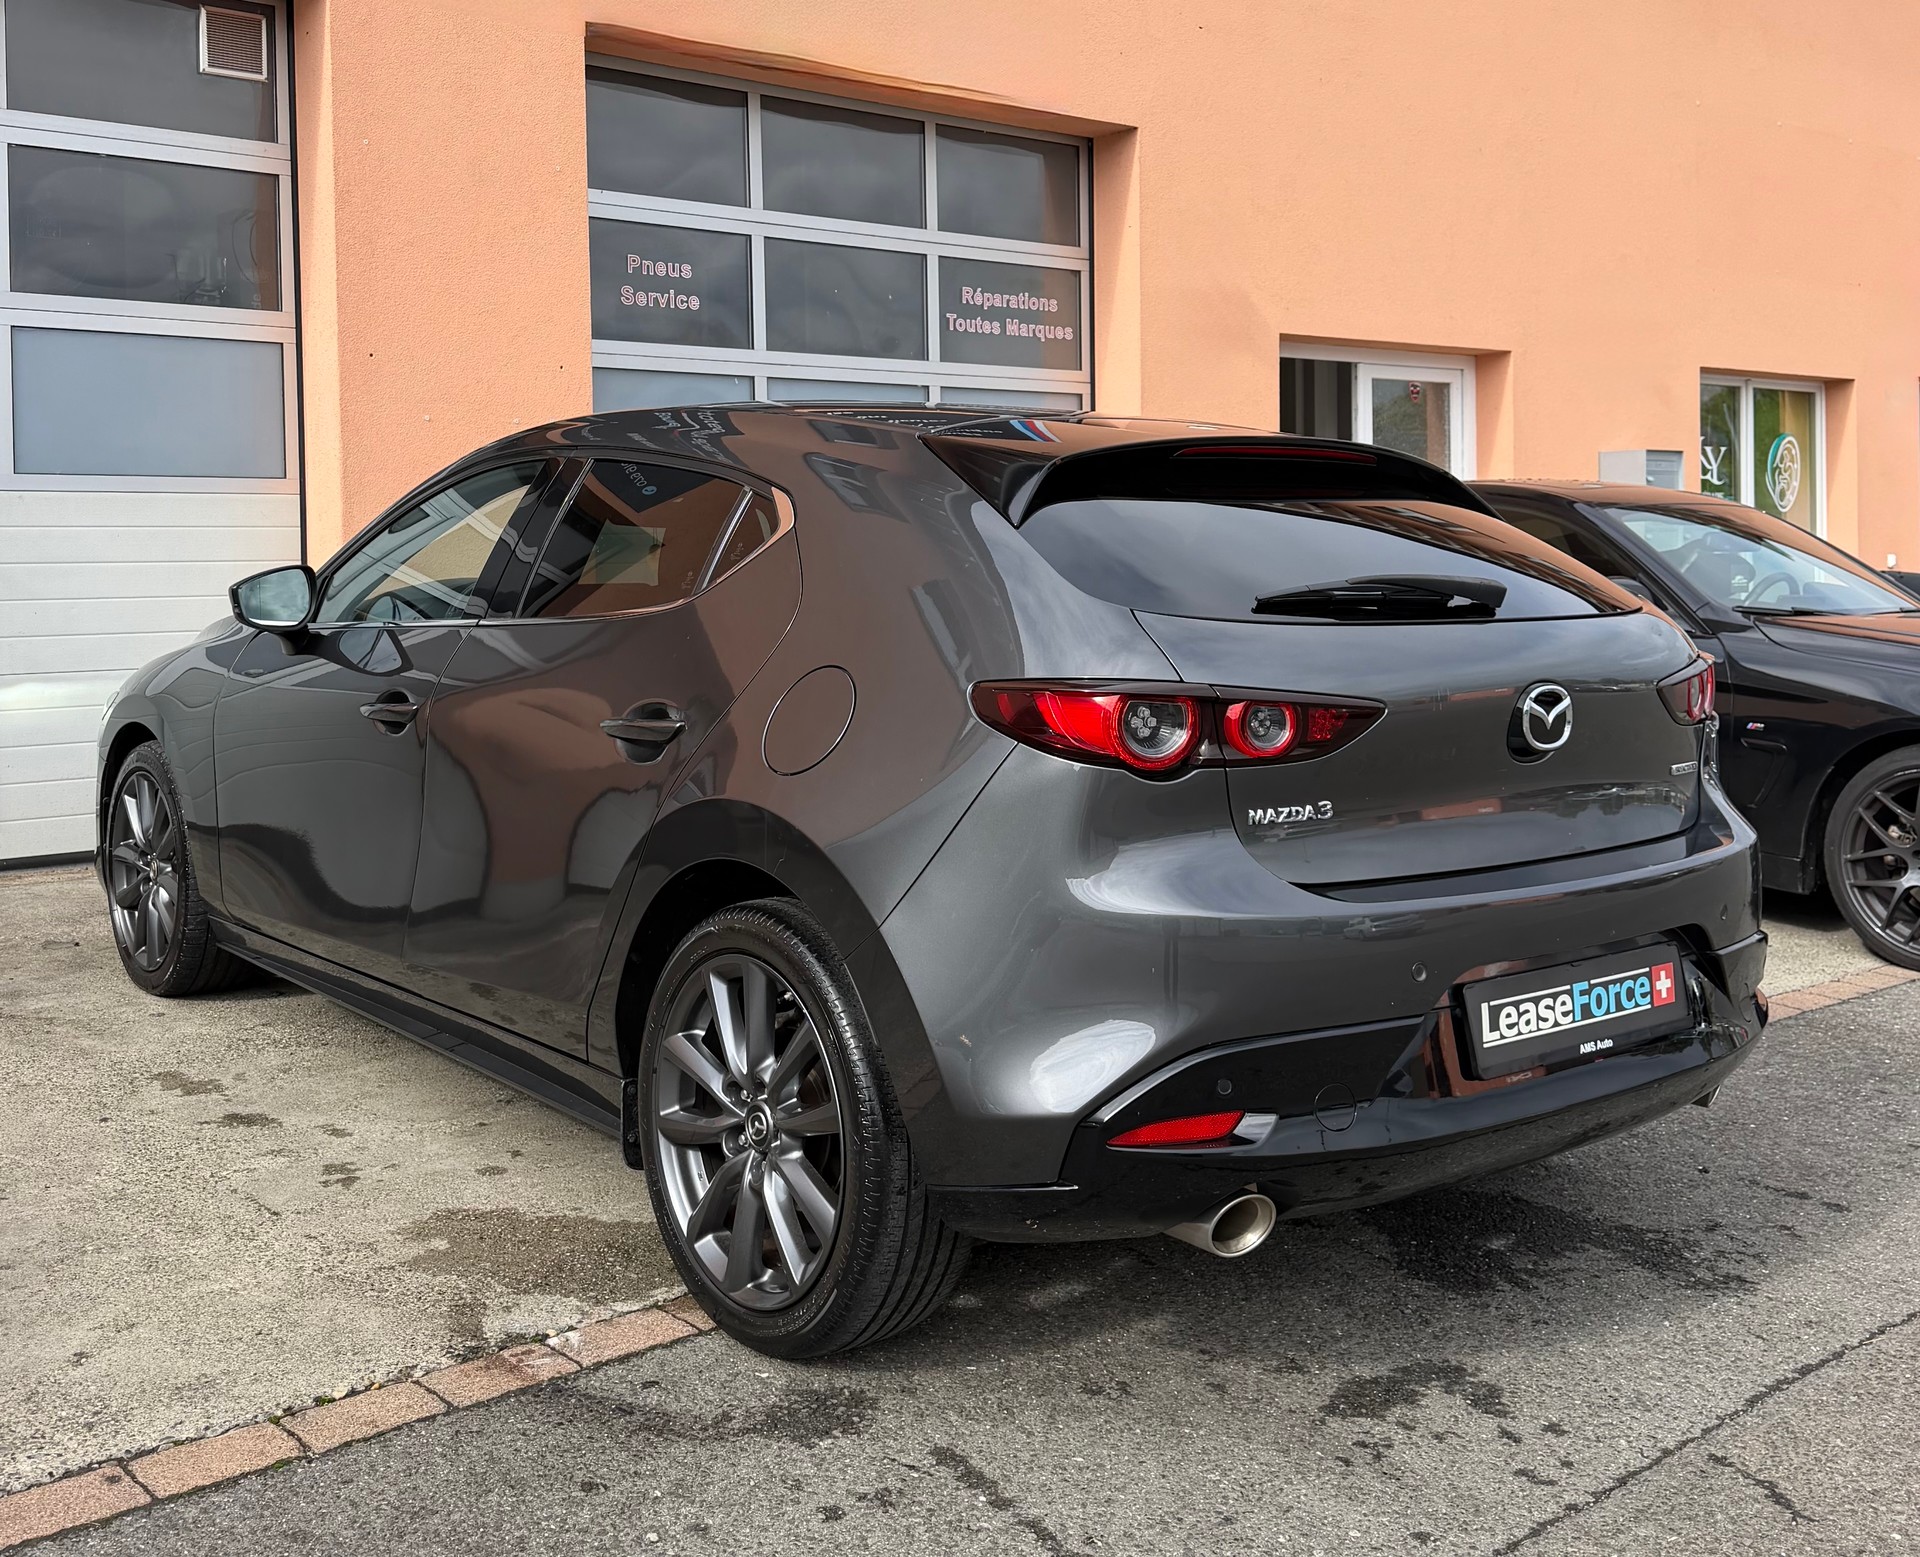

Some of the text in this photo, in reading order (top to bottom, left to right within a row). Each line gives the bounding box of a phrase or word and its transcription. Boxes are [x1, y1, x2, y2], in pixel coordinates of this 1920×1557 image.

[627, 254, 693, 279] Pneus
[620, 286, 701, 311] Service
[961, 287, 1058, 313] Réparations
[946, 313, 1074, 343] Toutes Marques
[1247, 800, 1334, 827] MAZDA3
[1481, 975, 1651, 1042] LeaseForce
[1579, 1038, 1614, 1055] AMS Auto
